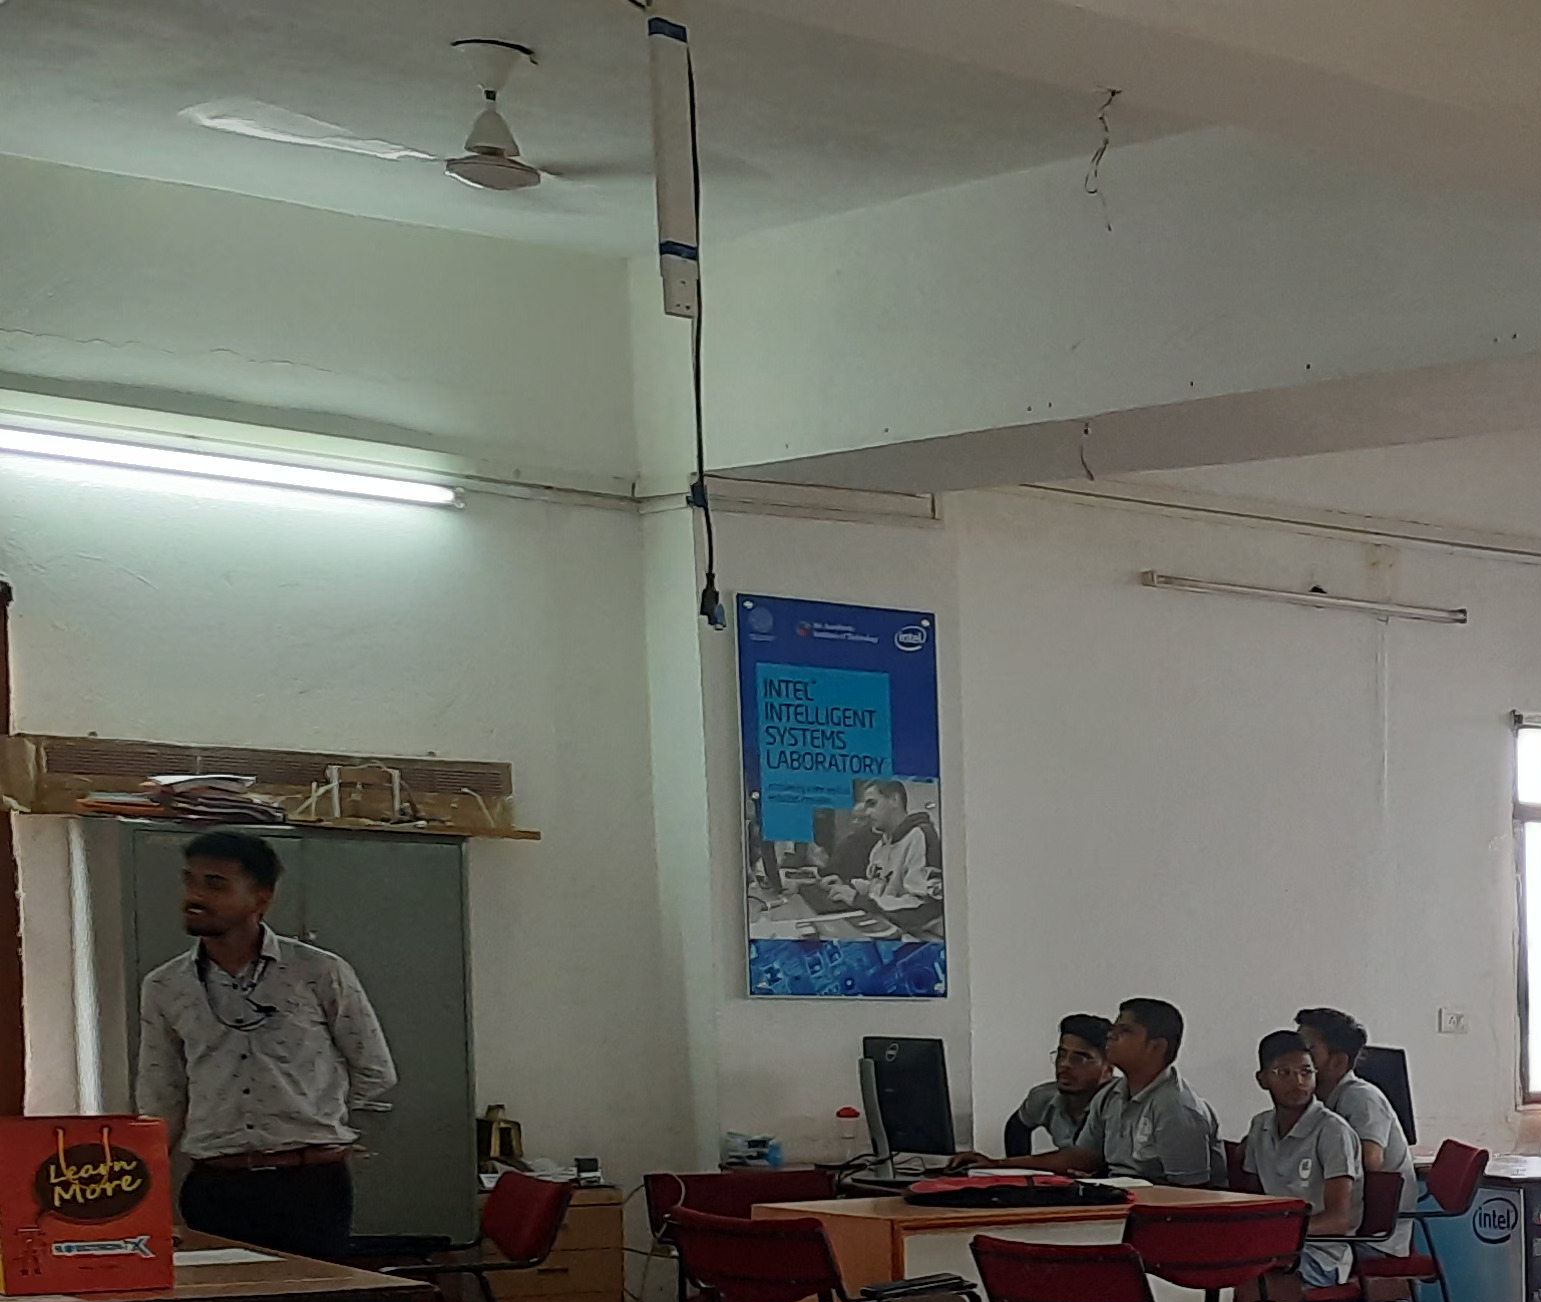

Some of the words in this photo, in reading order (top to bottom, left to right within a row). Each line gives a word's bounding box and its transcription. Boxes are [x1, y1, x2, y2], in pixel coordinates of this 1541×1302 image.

[763, 679, 814, 701] INTEL
[764, 701, 876, 728] INTELLIGENT
[765, 725, 846, 750] SYSTEMS
[766, 749, 886, 774] LABORATORY
[49, 1160, 137, 1184] Learn
[53, 1174, 143, 1208] More
[1478, 1206, 1510, 1230] intel
